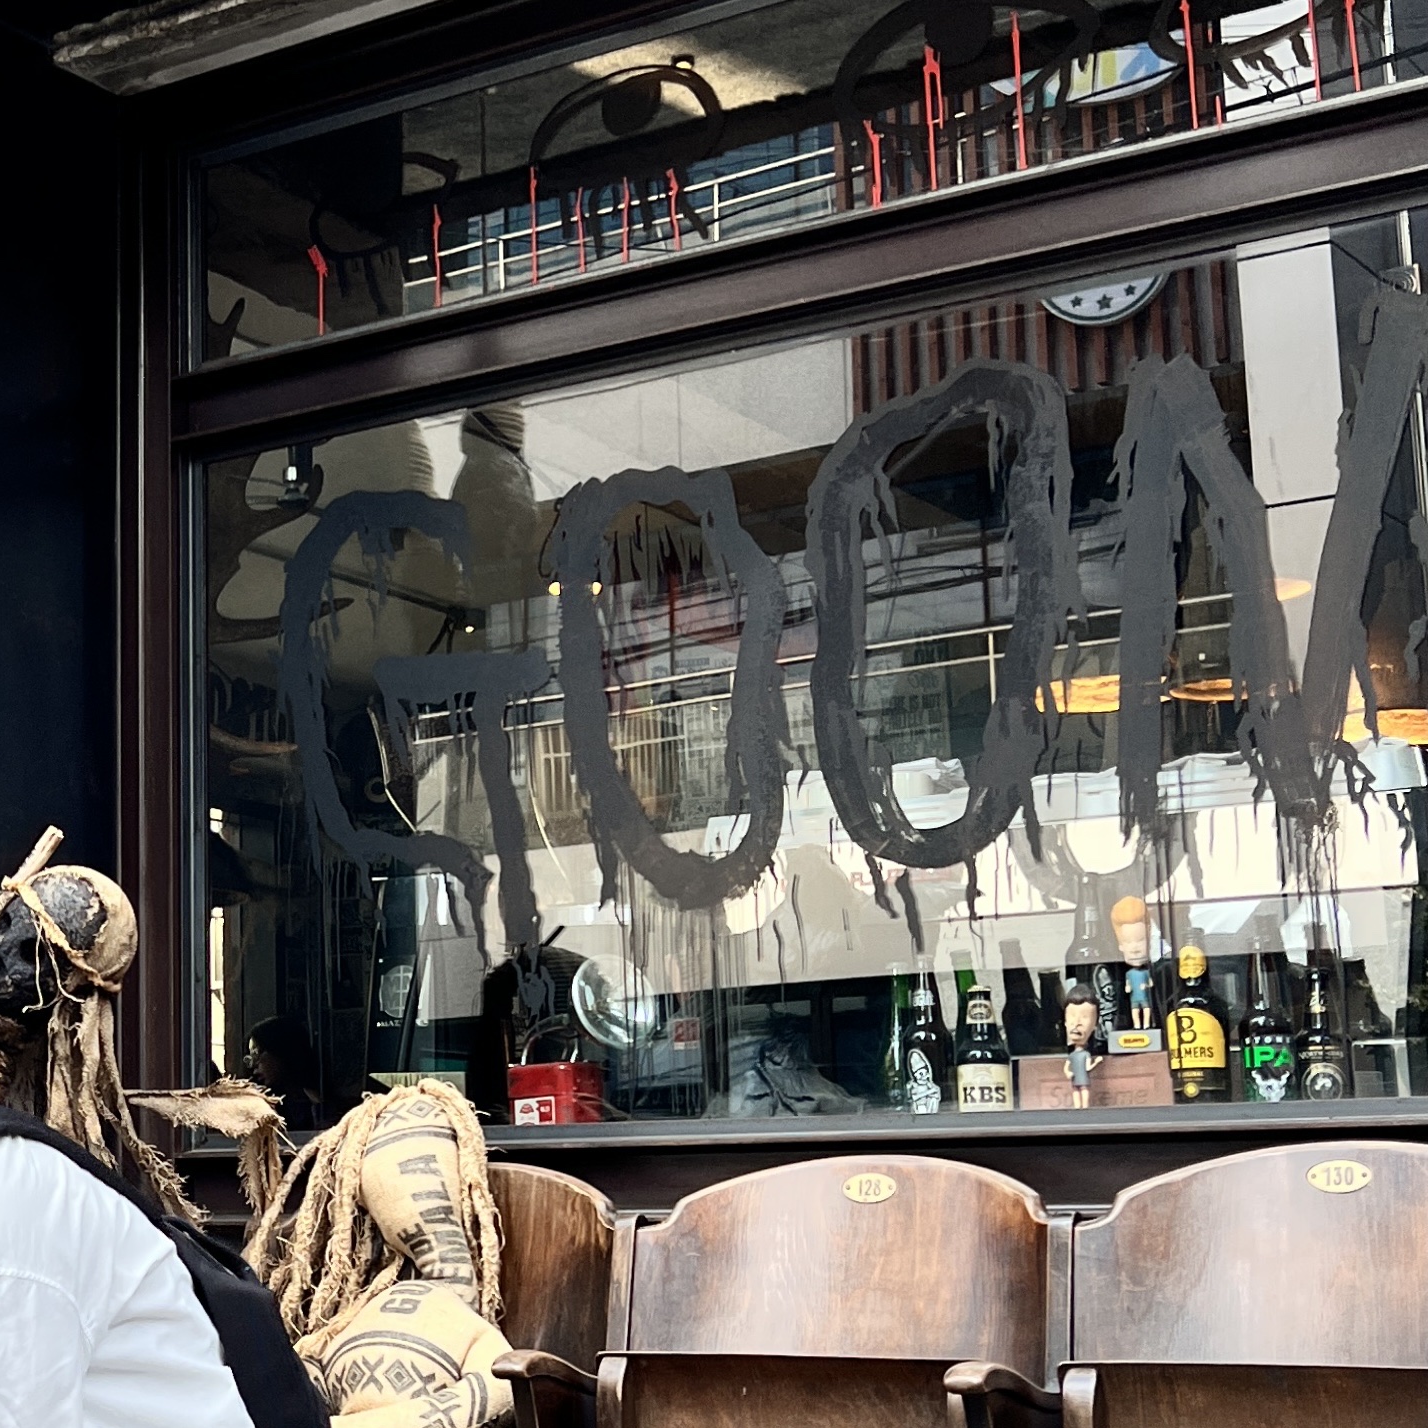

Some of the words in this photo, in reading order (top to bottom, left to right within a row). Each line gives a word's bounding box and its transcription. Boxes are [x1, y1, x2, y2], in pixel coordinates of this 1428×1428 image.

[1243, 1045, 1293, 1068] IPA
[962, 1085, 1008, 1104] KBS
[1323, 1166, 1354, 1187] 130
[857, 1179, 881, 1197] 128
